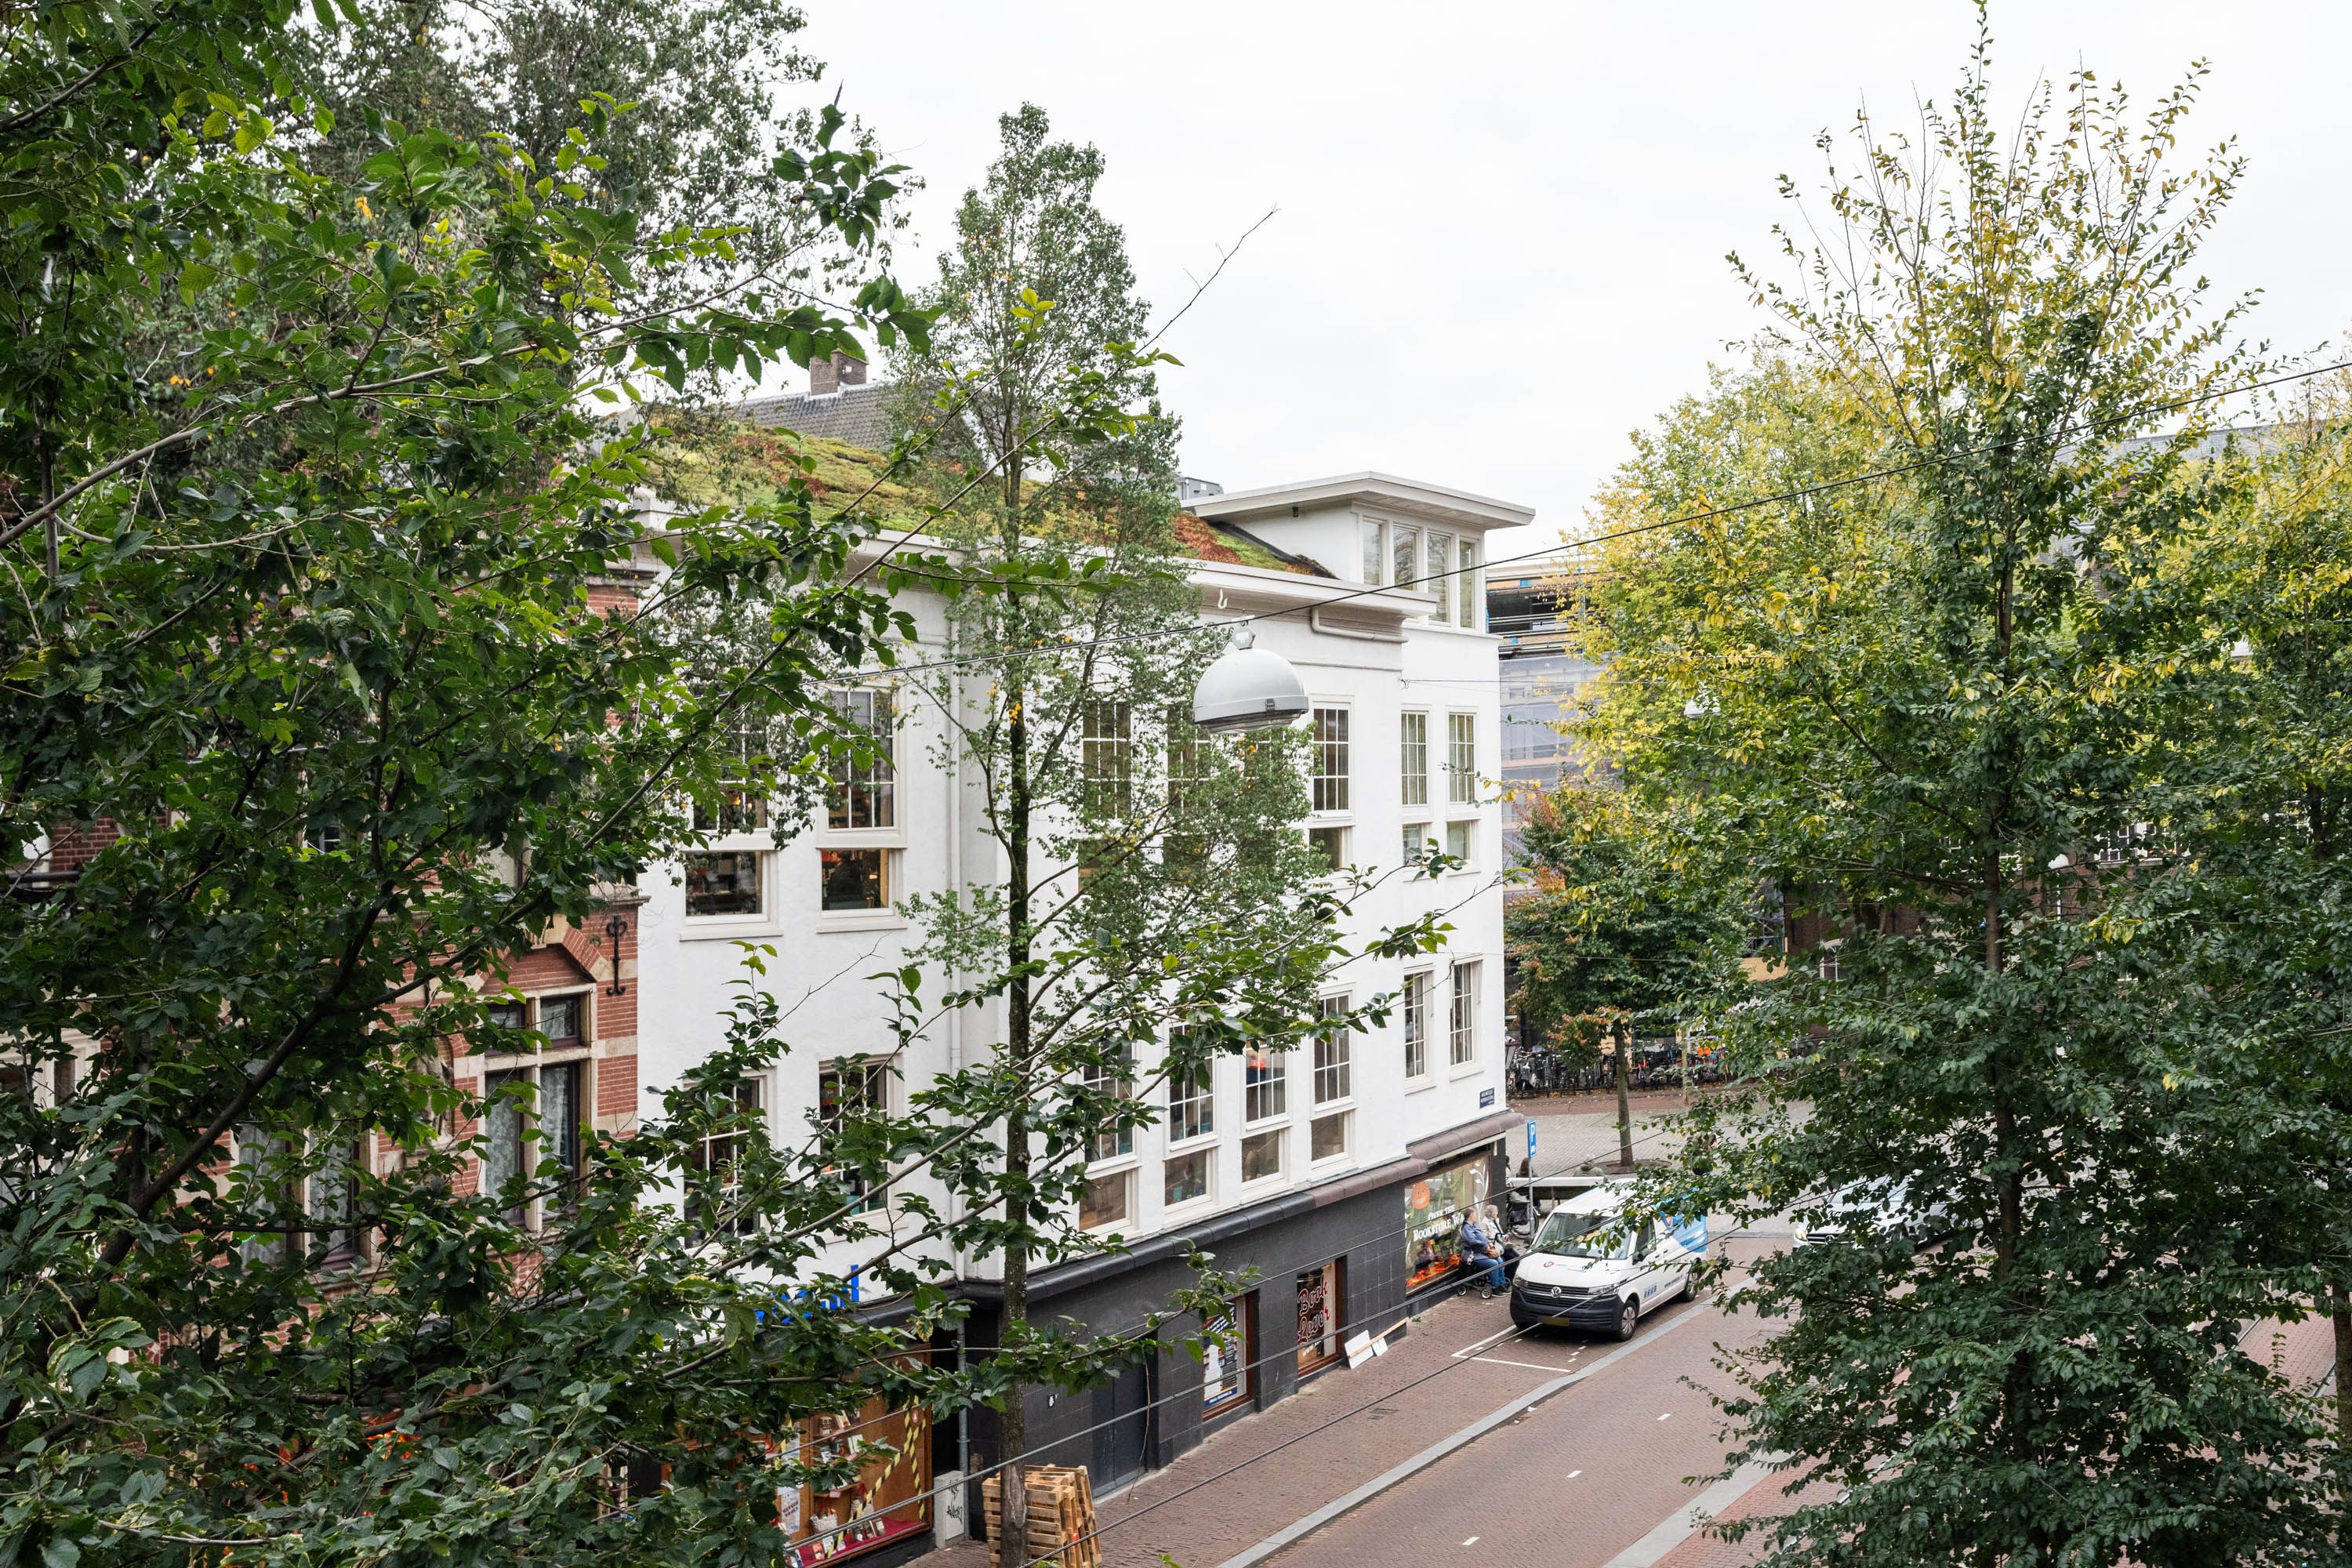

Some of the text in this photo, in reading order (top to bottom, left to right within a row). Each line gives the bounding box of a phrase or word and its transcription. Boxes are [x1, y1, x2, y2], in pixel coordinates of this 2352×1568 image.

[1530, 1124, 1535, 1142] P
[1414, 1219, 1451, 1242] BOOKSTORE
[1298, 1273, 1328, 1316] Book
